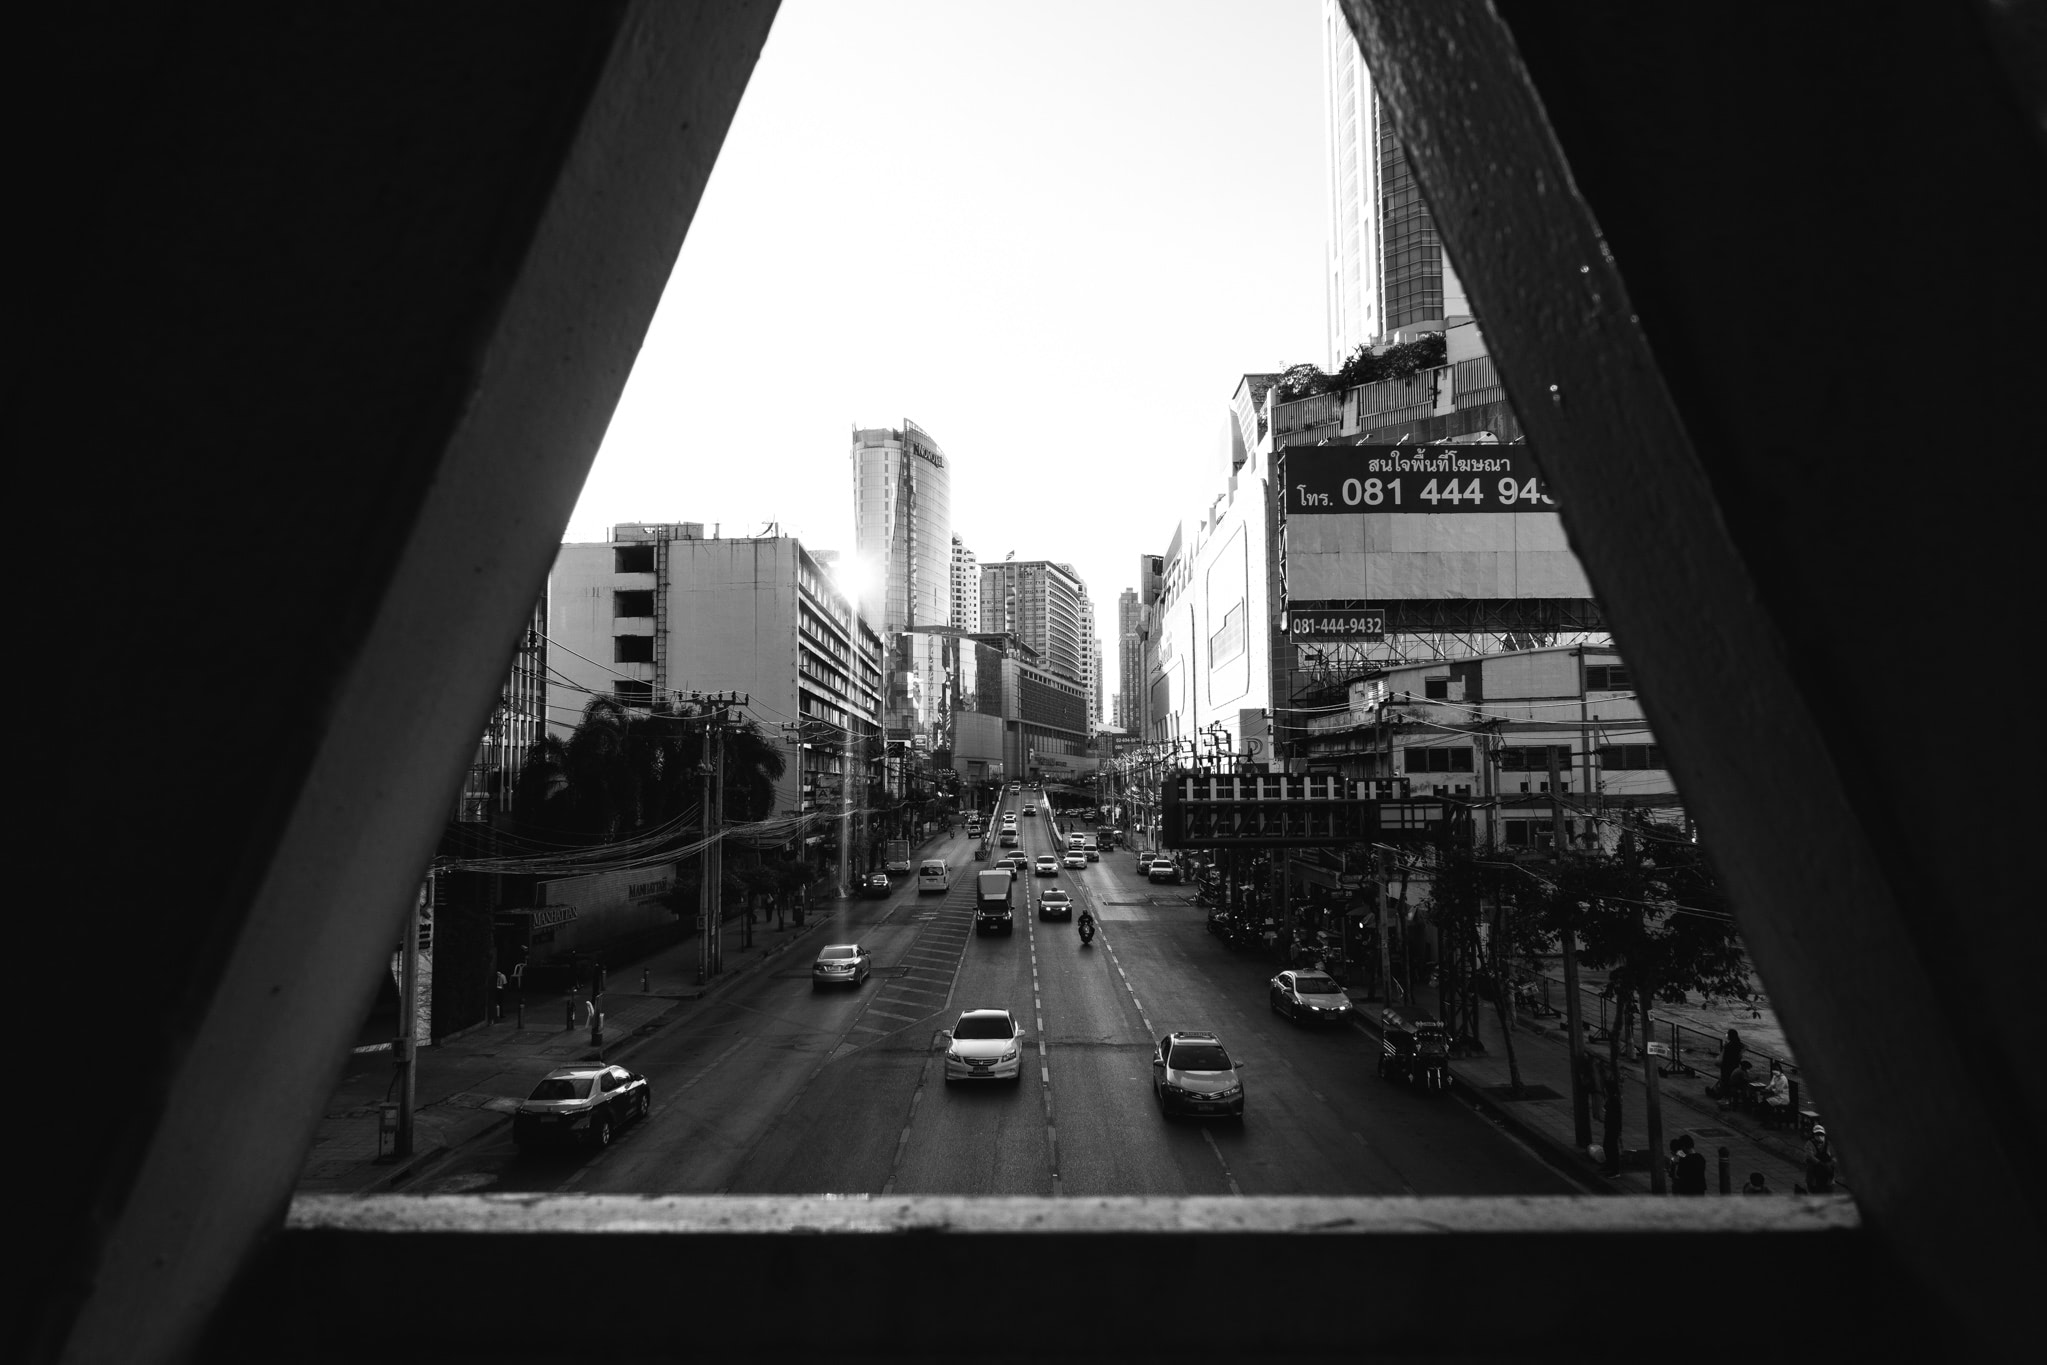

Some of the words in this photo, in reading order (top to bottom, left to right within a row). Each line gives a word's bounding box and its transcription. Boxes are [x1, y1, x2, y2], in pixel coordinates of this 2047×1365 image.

[1368, 448, 1511, 472] สนใจพื้นที่โฆษณา
[1297, 484, 1333, 506] โทร.
[1342, 478, 1402, 506] 081
[1420, 478, 1484, 505] 444
[1293, 617, 1383, 635] 081-444-9432
[533, 906, 577, 927] MANHATTAN
